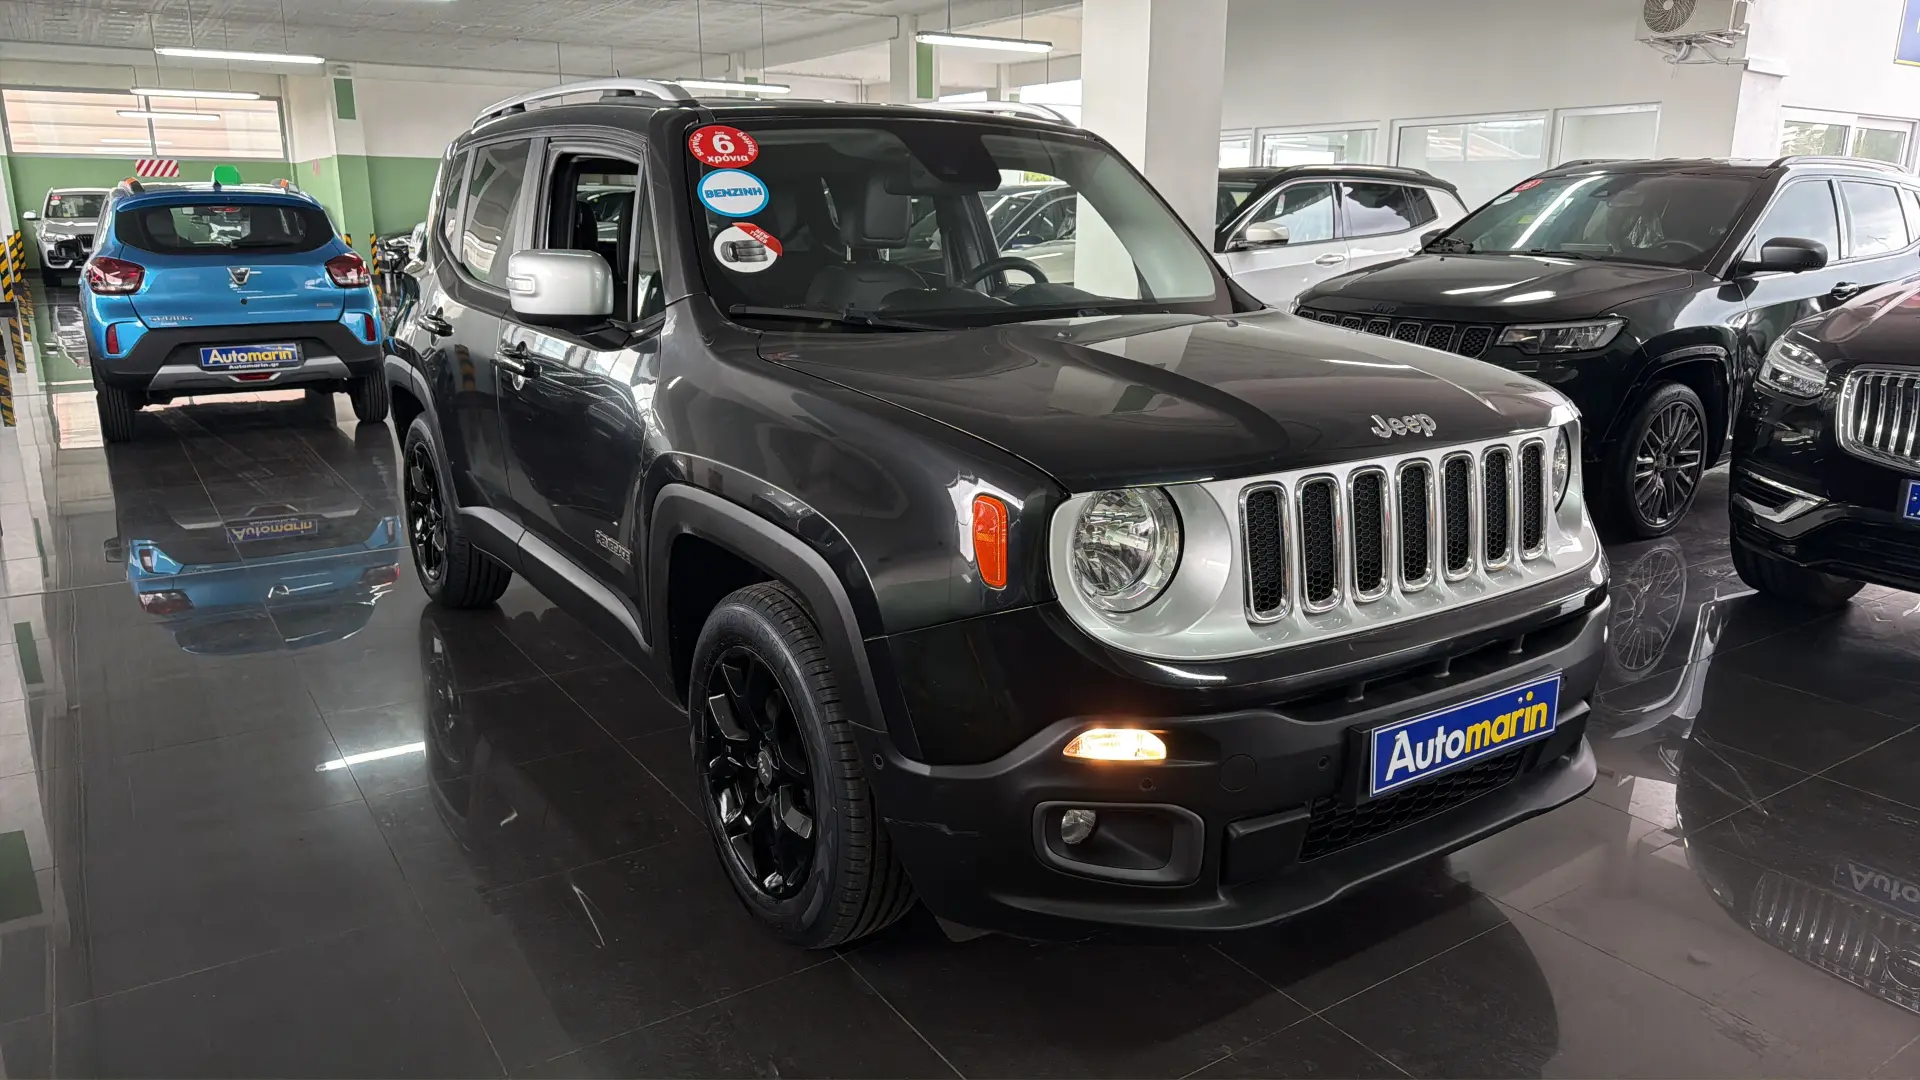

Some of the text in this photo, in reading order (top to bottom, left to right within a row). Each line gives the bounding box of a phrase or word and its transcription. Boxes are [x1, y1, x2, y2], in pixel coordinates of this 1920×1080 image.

[688, 132, 704, 157] service
[712, 134, 735, 154] 6
[707, 154, 749, 164] χρόνια
[750, 230, 768, 244] TYRES
[755, 228, 770, 239] NEW
[208, 346, 293, 364] Automarin
[1370, 413, 1437, 438] Jeep
[1385, 690, 1549, 782] Automarin
